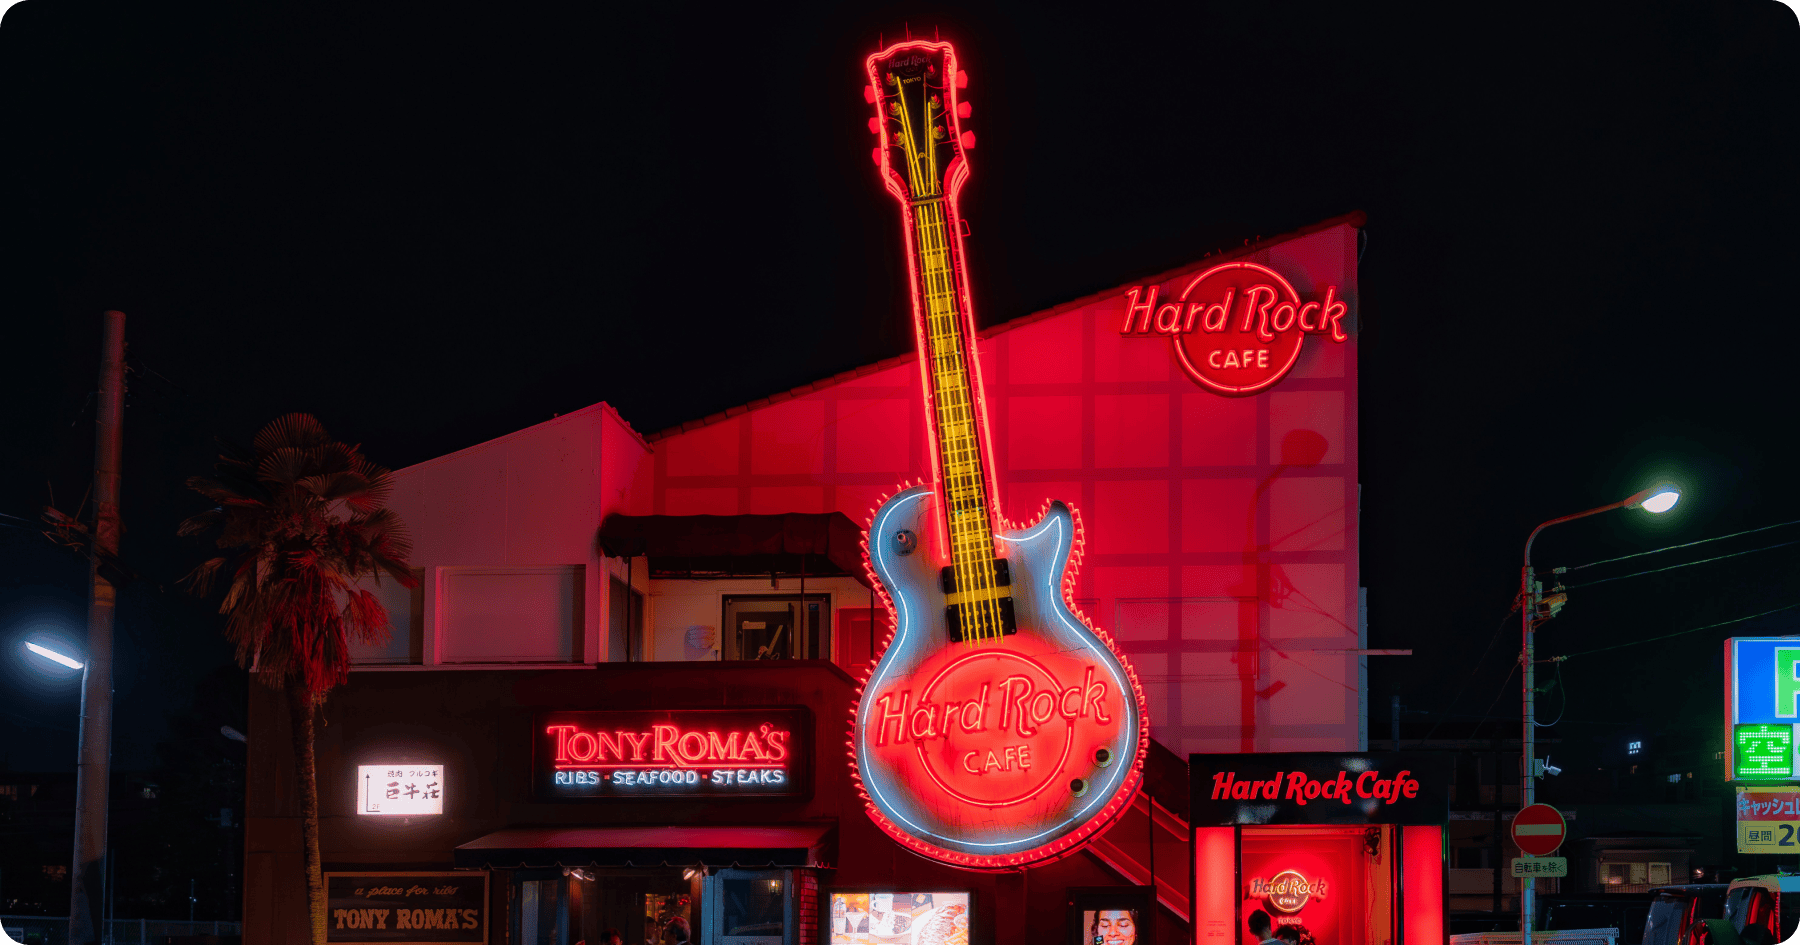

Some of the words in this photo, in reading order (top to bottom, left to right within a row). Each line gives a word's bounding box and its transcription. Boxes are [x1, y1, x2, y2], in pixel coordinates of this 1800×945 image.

[889, 56, 910, 68] Hard
[903, 76, 922, 84] TOKYO
[1119, 285, 1236, 334] Hard
[1240, 283, 1348, 343] Rock
[1207, 349, 1270, 369] CAFE
[876, 682, 990, 747] Hard
[998, 665, 1112, 738] Rock
[962, 744, 1032, 776] CAFE
[1739, 725, 1790, 775] 空
[555, 770, 600, 785] RIBS
[612, 770, 699, 785] SEAFOOD
[711, 769, 786, 785] STEAKS
[1211, 771, 1284, 800] Hard
[1285, 771, 1353, 806] Rock
[1355, 770, 1419, 805] Cafe
[1748, 830, 1772, 842] 昼間
[1778, 824, 1800, 847] 2
[1514, 861, 1564, 874] 自転車を除く
[354, 887, 365, 895] a
[365, 885, 403, 898] place
[405, 885, 430, 897] for
[432, 885, 460, 896] ribs
[333, 908, 390, 930] TONY
[396, 908, 479, 930] ROMA'S
